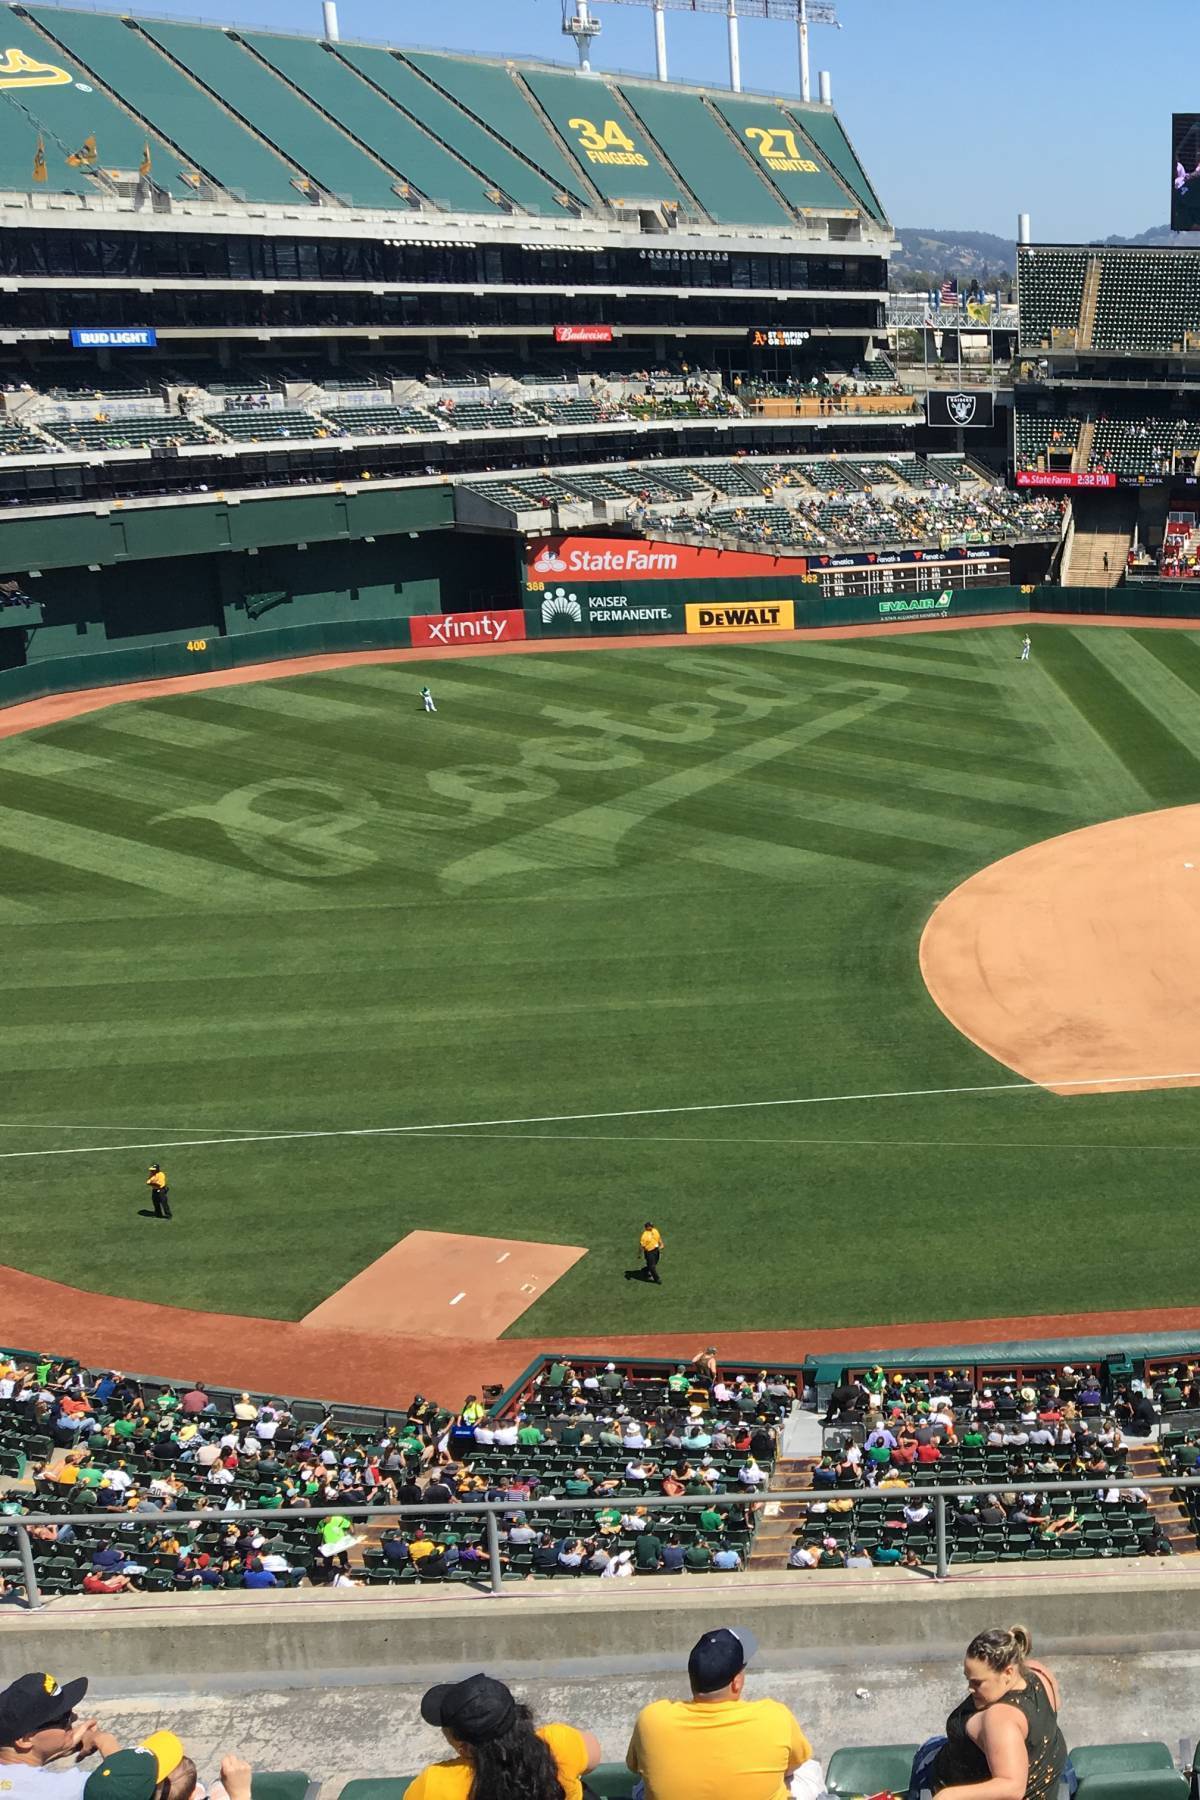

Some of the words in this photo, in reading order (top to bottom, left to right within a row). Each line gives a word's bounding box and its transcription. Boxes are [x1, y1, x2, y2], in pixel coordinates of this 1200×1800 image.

[569, 118, 634, 151] 34
[745, 127, 800, 158] 27
[586, 150, 648, 166] FINGERS
[765, 158, 820, 172] HUNTER
[80, 332, 109, 343] BUD
[110, 332, 148, 343] LIGHT
[557, 327, 609, 341] Budweiser
[1077, 474, 1094, 485] 2:32
[1096, 474, 1109, 485] PM
[967, 550, 990, 558] Fanatics
[801, 575, 818, 584] 362
[1021, 585, 1035, 594] 367
[589, 597, 628, 608] KAISER
[589, 608, 668, 621] PERMANENTE
[428, 615, 507, 643] xfinity
[187, 640, 206, 651] 400
